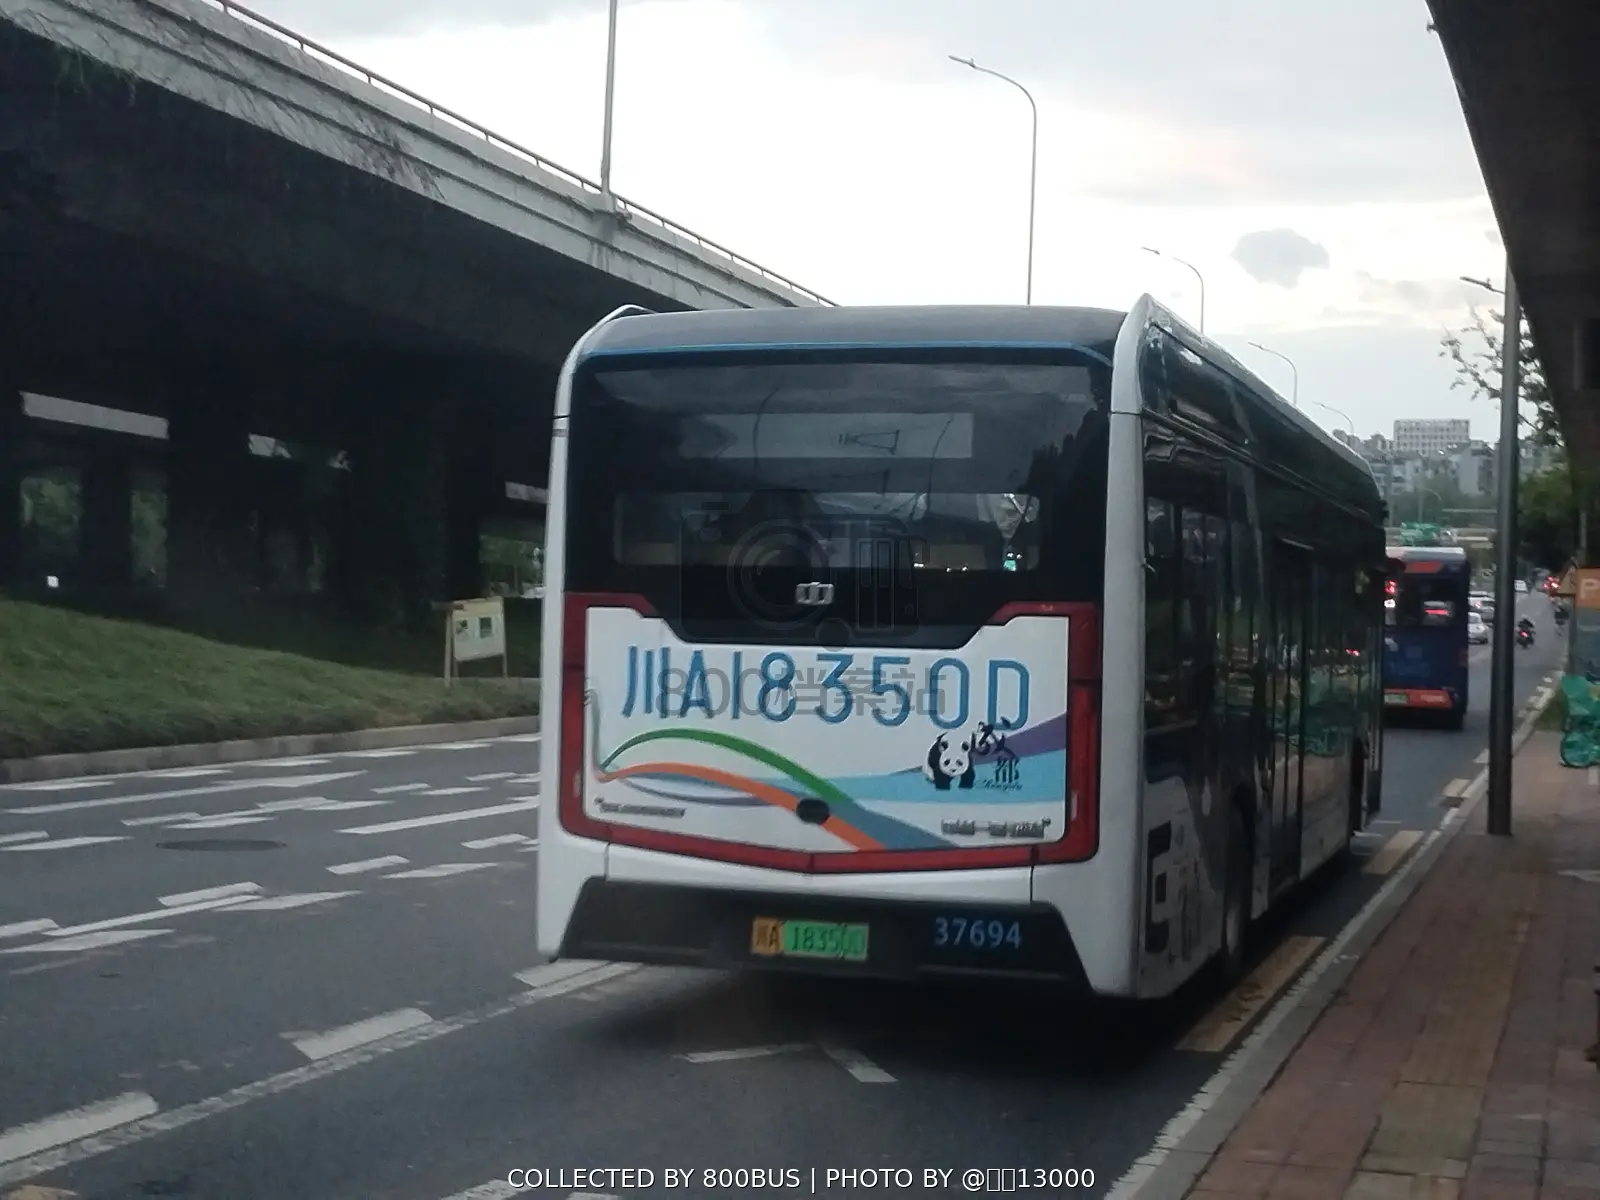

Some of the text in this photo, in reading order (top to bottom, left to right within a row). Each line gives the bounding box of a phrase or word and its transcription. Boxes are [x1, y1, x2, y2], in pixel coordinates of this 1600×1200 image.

[1581, 578, 1600, 600] P
[621, 645, 1030, 731] 川A18350D
[935, 917, 1021, 949] 37694
